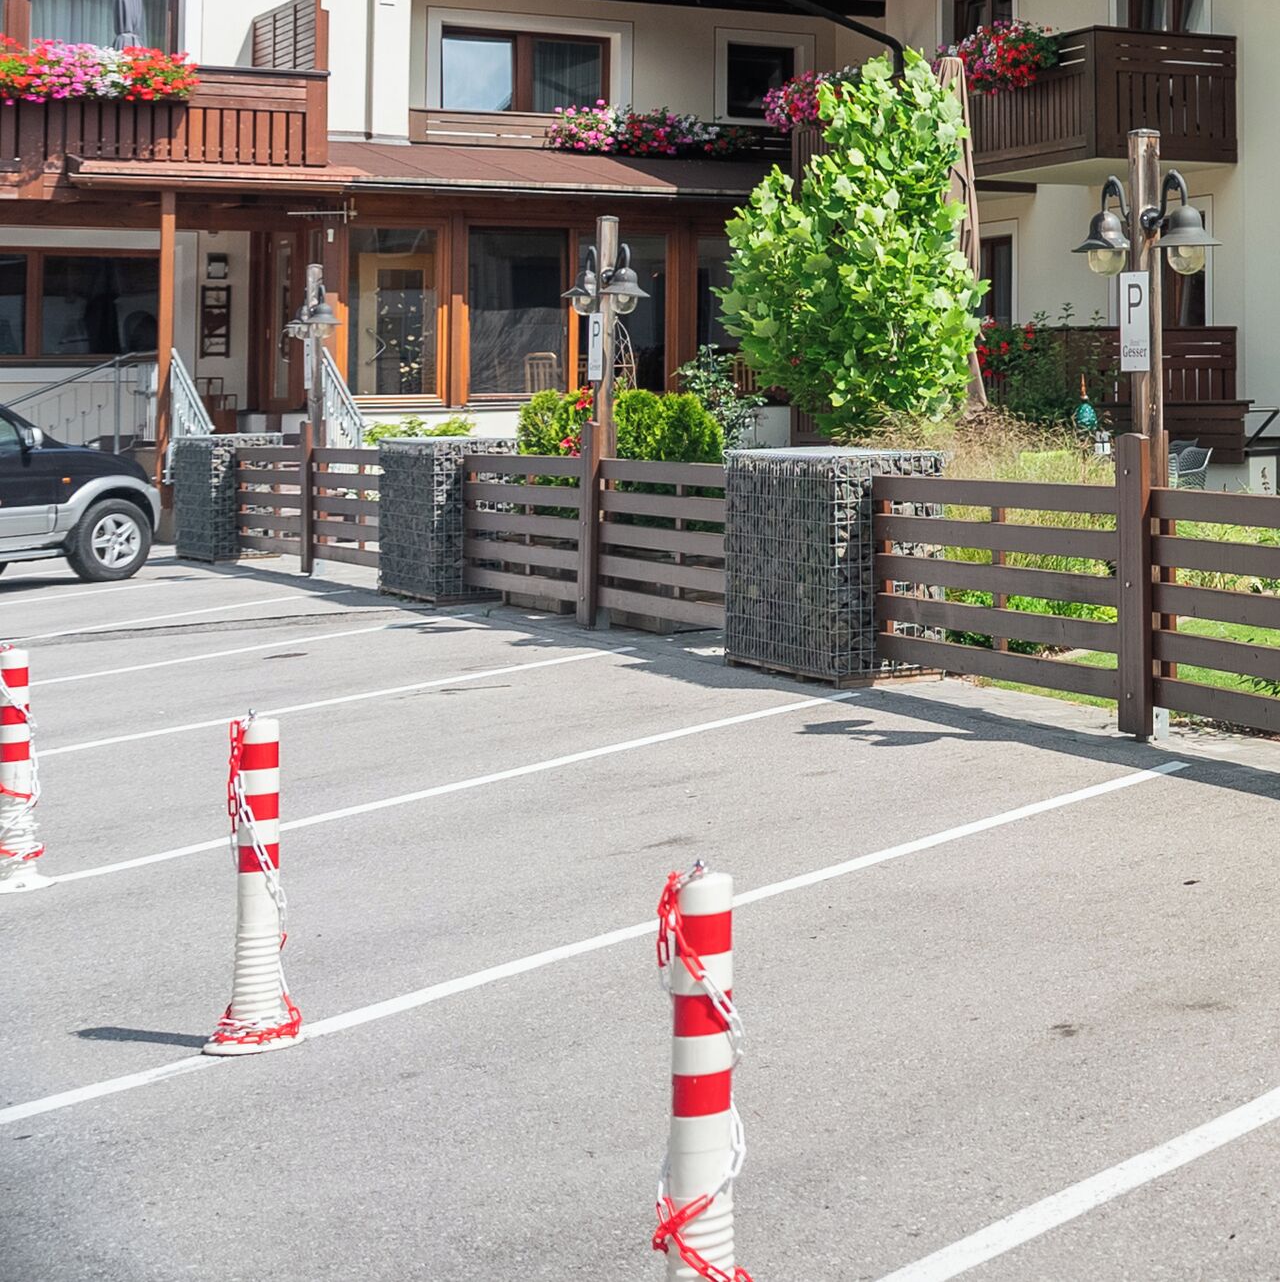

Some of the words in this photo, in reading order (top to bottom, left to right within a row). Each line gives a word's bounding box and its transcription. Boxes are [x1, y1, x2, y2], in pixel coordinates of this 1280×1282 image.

[1128, 283, 1143, 324] P
[593, 321, 601, 348] P
[1122, 345, 1148, 358] Gesser
